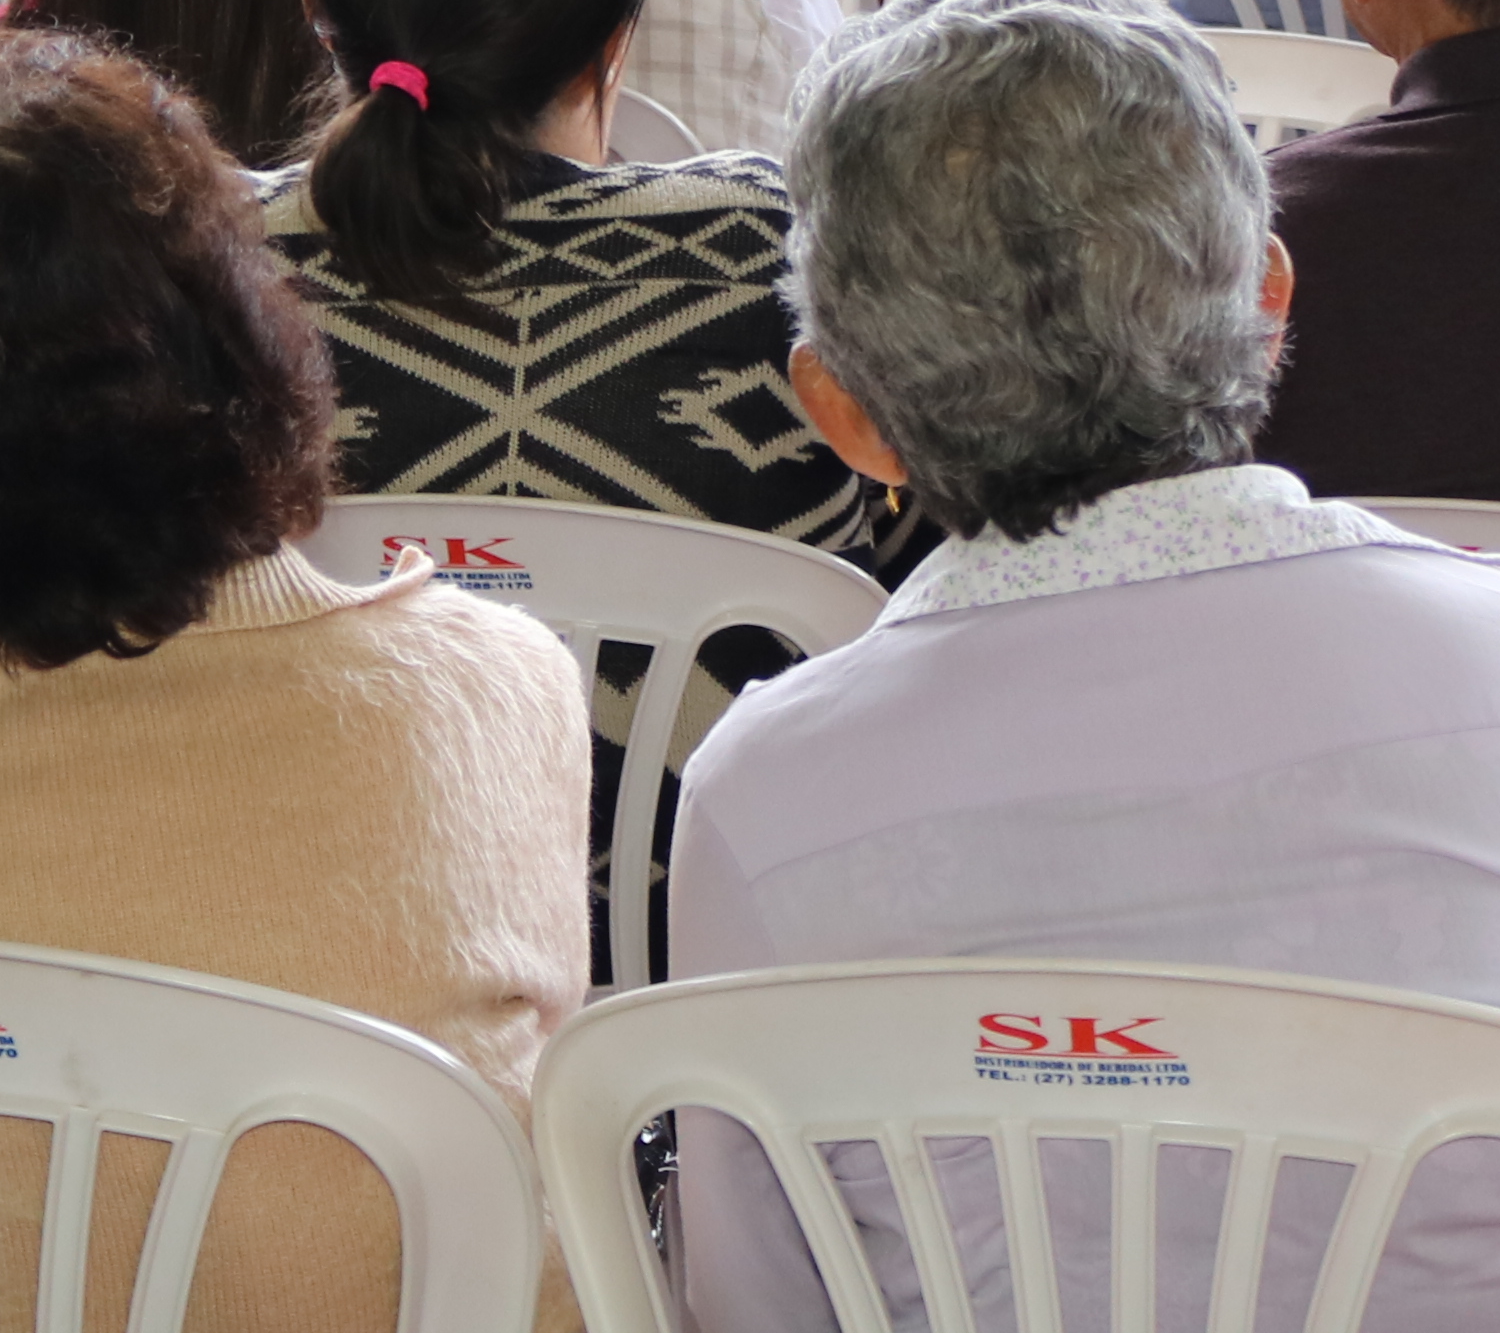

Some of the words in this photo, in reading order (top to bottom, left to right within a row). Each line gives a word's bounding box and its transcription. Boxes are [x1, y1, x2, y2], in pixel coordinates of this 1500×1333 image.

[977, 1012, 1177, 1056] SK
[974, 1055, 1074, 1070] DISTRIBUIDORA
[1076, 1061, 1093, 1071] DE
[1097, 1062, 1153, 1073] BEBIDAS
[1156, 1063, 1188, 1074] LTDA
[976, 1068, 1028, 1082] TEL.:
[1033, 1072, 1074, 1086] (27)
[1080, 1075, 1191, 1086] 3288-1170
